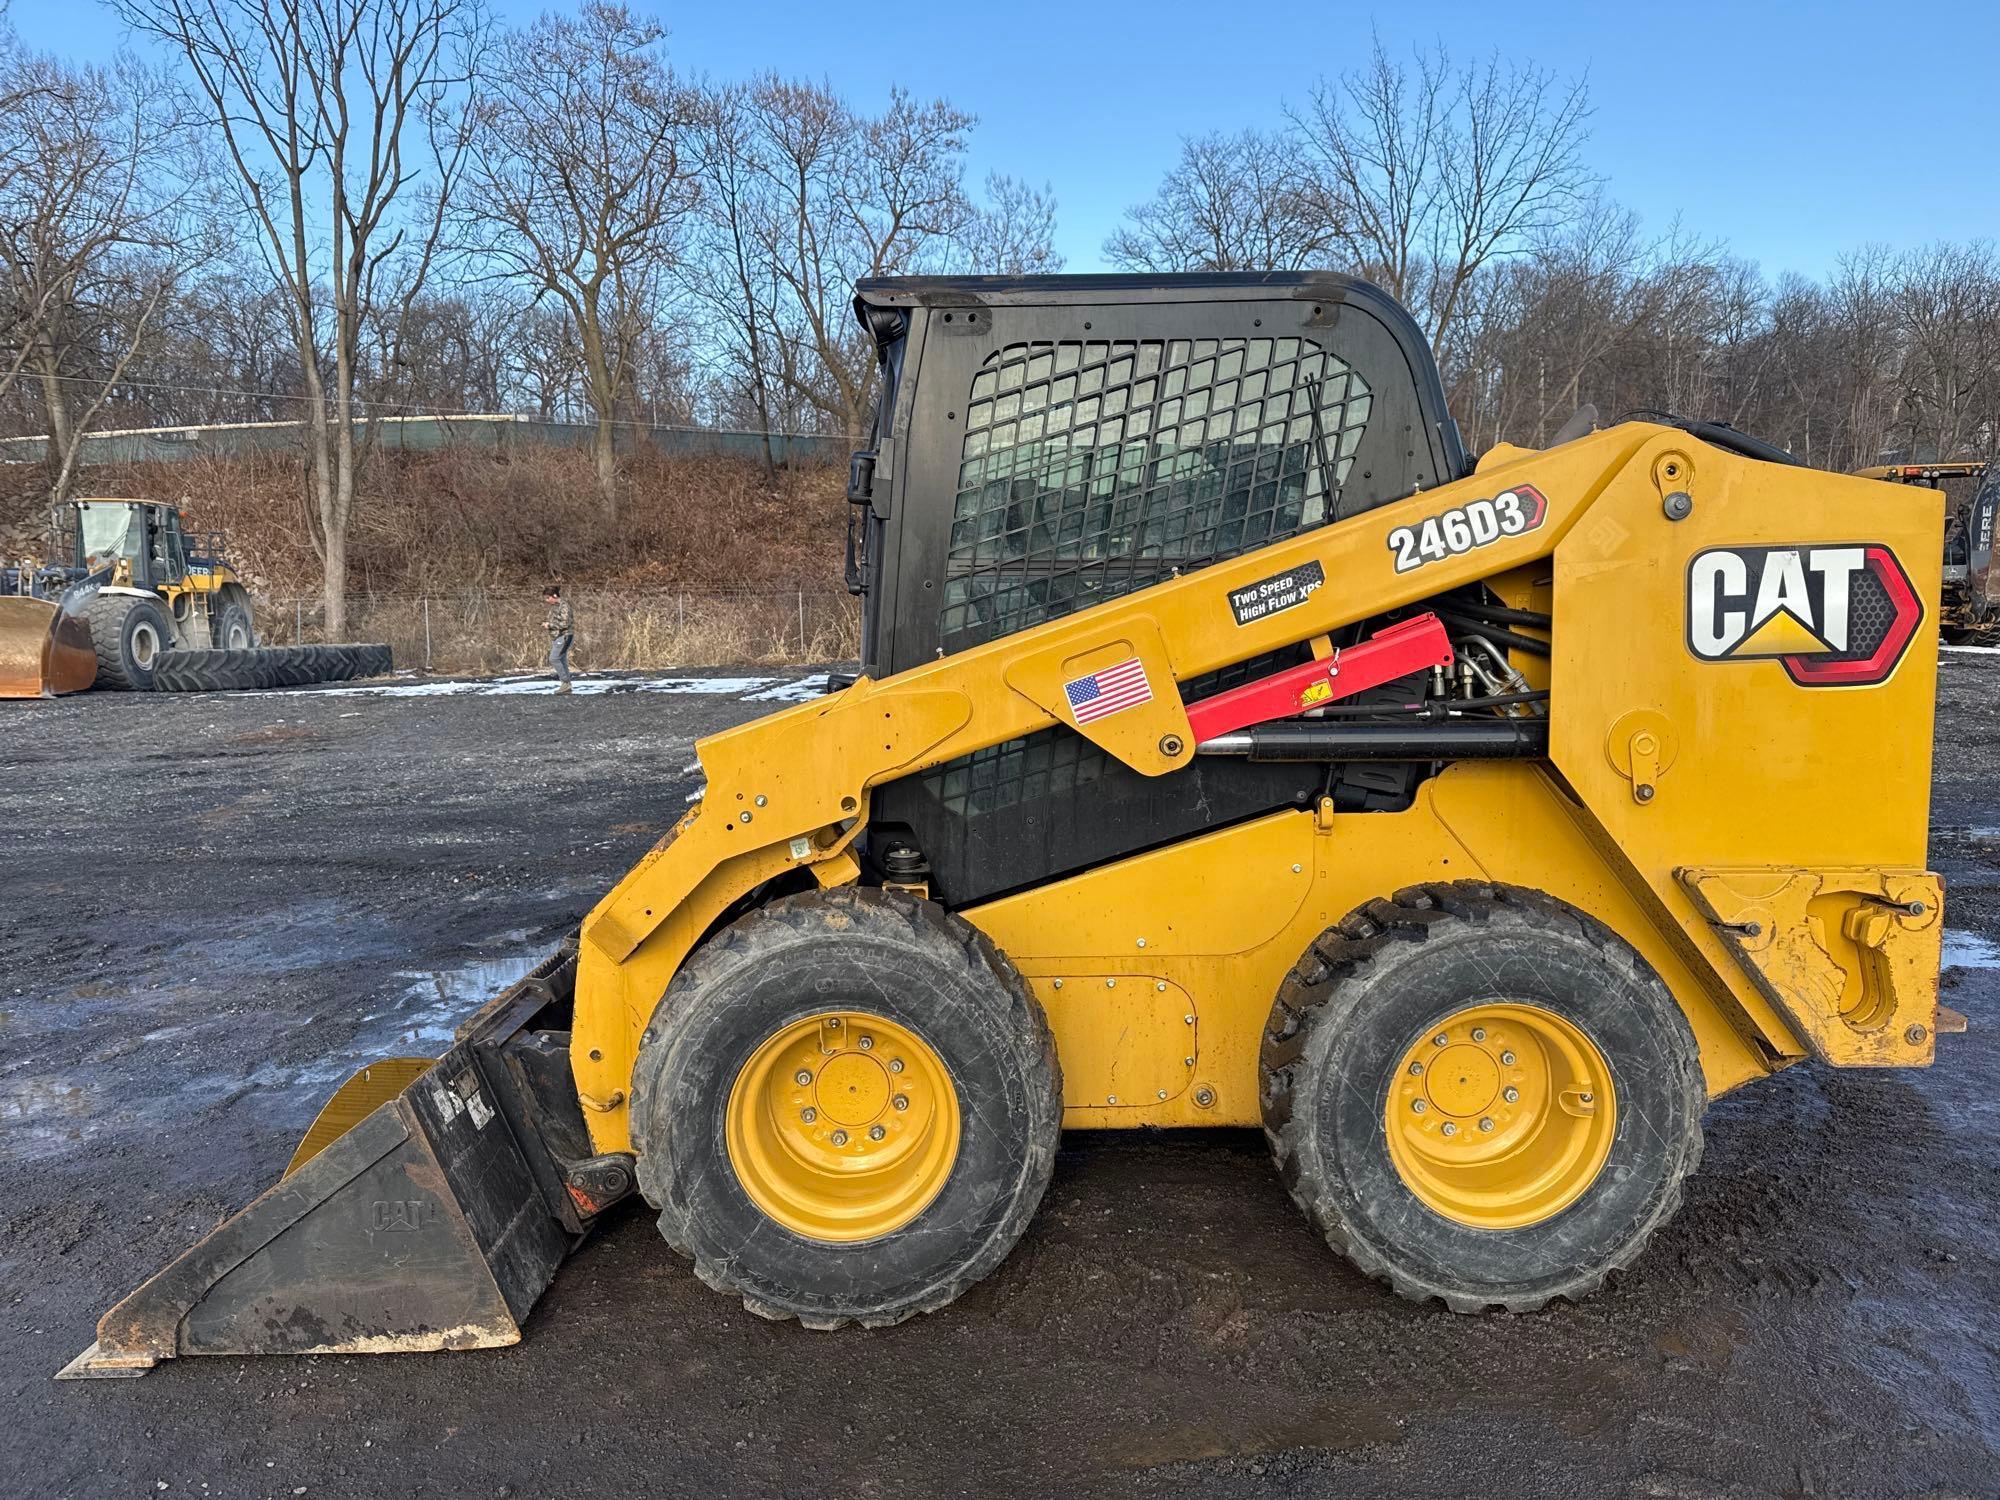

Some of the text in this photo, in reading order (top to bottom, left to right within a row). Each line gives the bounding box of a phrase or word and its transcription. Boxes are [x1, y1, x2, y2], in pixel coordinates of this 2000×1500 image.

[1389, 492, 1525, 571] 246D3
[1232, 577, 1293, 607] TWO SPEED
[1240, 603, 1265, 621] HIGH
[1268, 592, 1296, 611] FLOW
[1691, 548, 1865, 657] CAT
[373, 1201, 424, 1231] CAT
